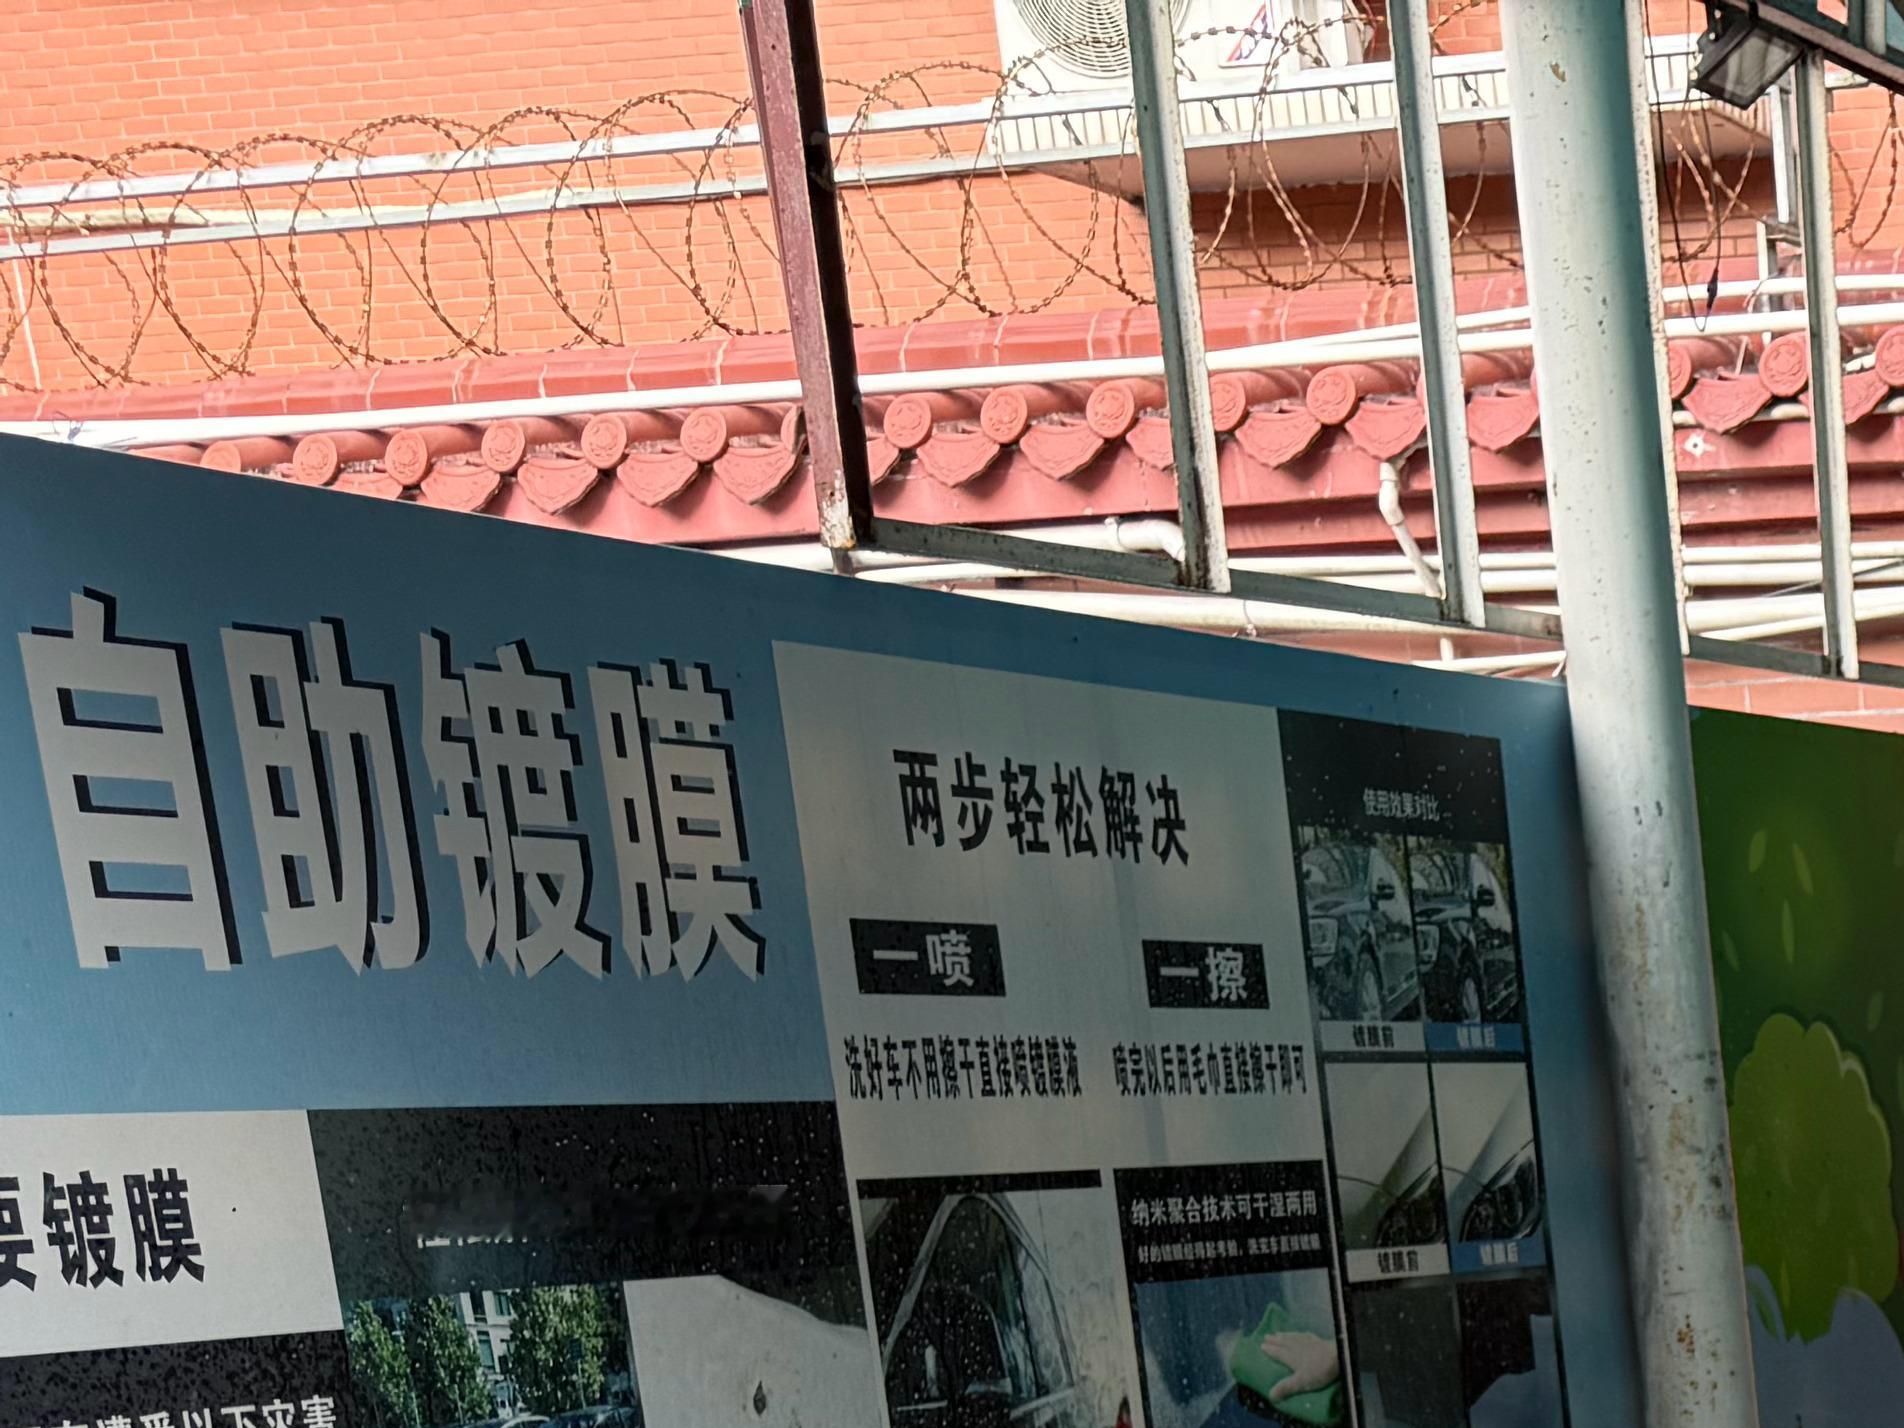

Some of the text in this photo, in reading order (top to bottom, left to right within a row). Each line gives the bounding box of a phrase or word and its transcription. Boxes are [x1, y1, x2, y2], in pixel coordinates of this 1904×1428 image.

[18, 585, 766, 982] 自助镀膜
[893, 748, 1190, 867] 两步轻松解决
[873, 930, 975, 989] 一喷
[1158, 944, 1249, 1003] 一擦
[844, 1034, 1082, 1101] 洗好车不用擦干直接喷镀膜液
[1113, 1041, 1307, 1096] 喷完以后用毛巾直接擦干即可
